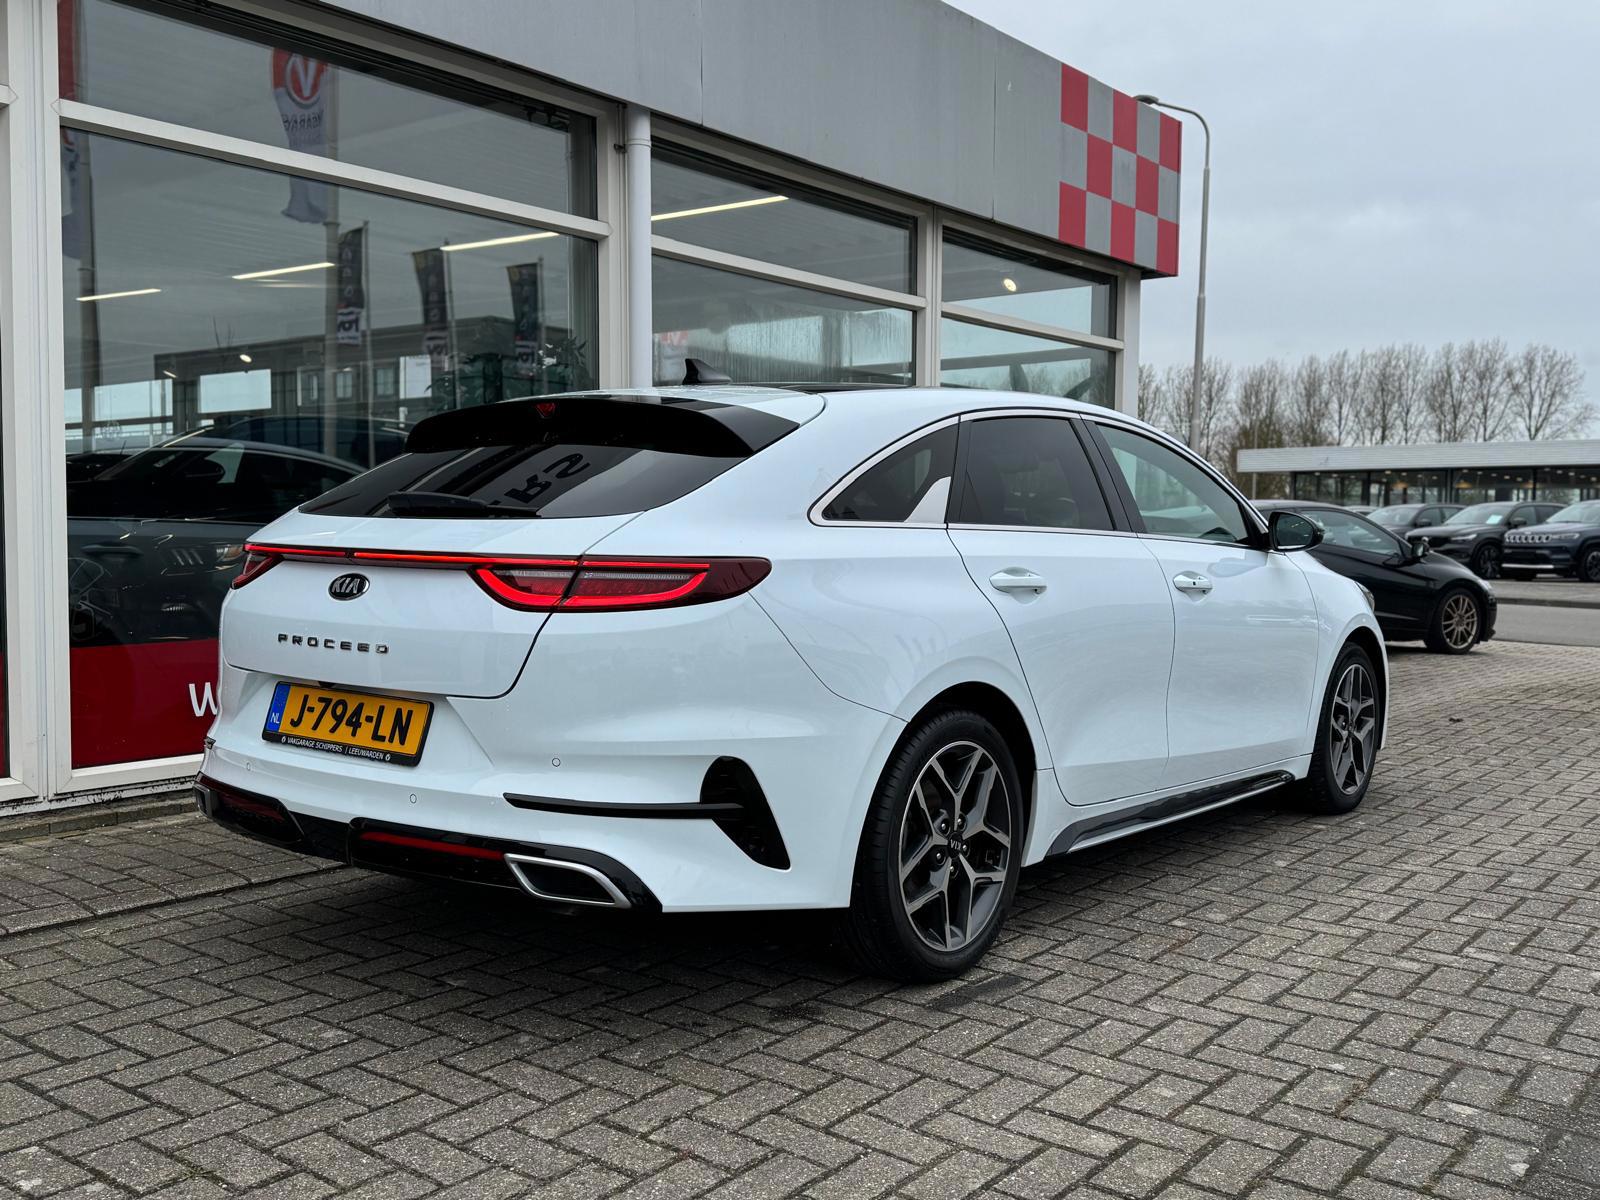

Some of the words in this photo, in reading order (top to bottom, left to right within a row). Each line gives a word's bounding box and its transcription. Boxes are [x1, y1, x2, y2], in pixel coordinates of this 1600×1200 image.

[331, 577, 360, 594] KIA
[277, 633, 390, 654] PROCEED
[270, 712, 280, 725] NL
[289, 694, 414, 746] J-794-LN
[287, 736, 315, 748] VAKGARAGE
[315, 742, 343, 753] SCHIPPERS
[348, 747, 384, 760] LEEUWARDEN
